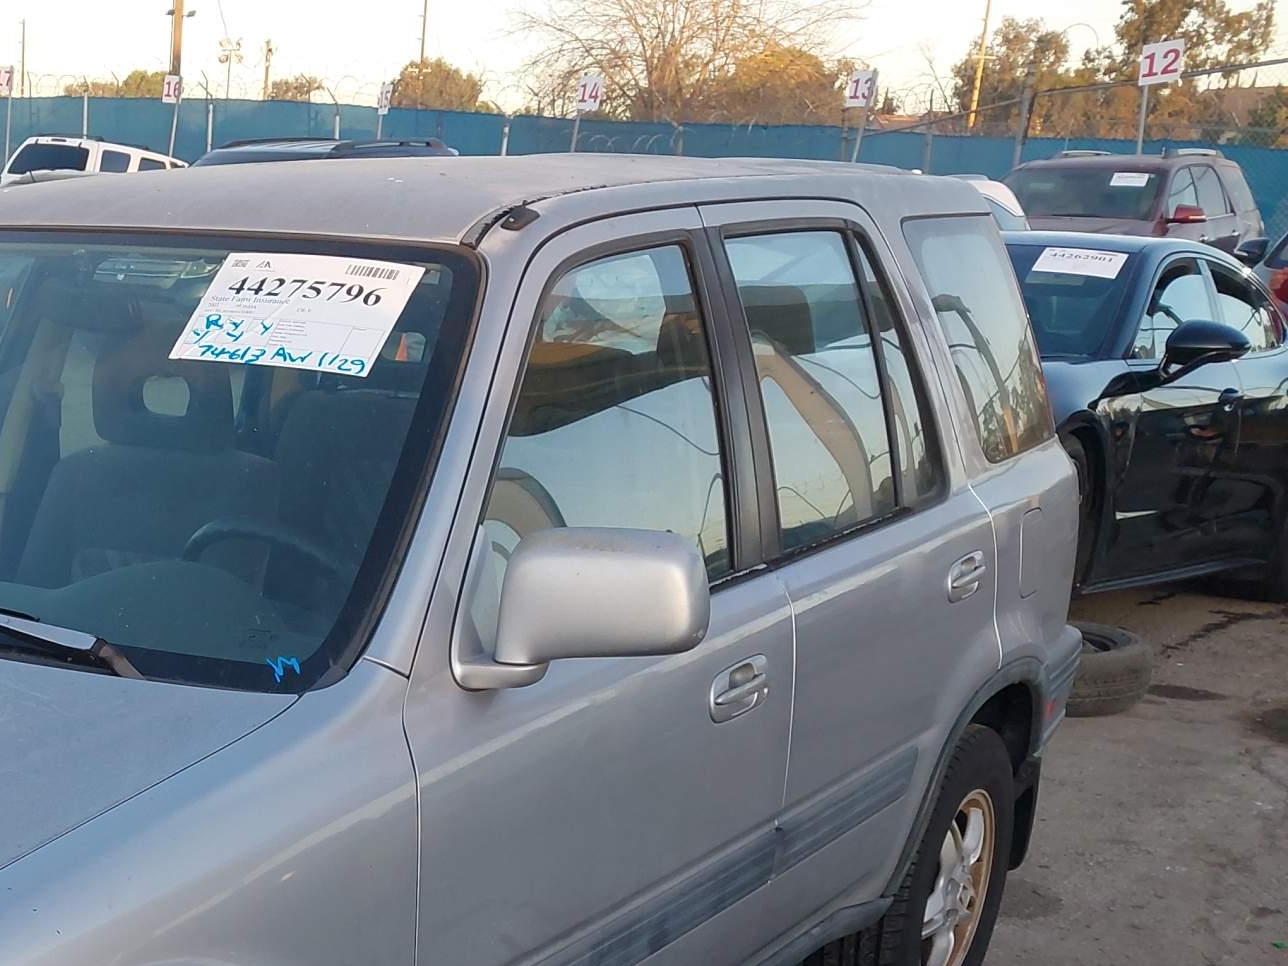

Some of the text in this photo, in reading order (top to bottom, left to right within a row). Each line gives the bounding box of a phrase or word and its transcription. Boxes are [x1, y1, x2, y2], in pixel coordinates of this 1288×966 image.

[1142, 48, 1181, 78] 12
[164, 81, 182, 98] 16
[578, 82, 600, 103] 14
[849, 77, 874, 100] 13
[227, 276, 389, 307] 44275796
